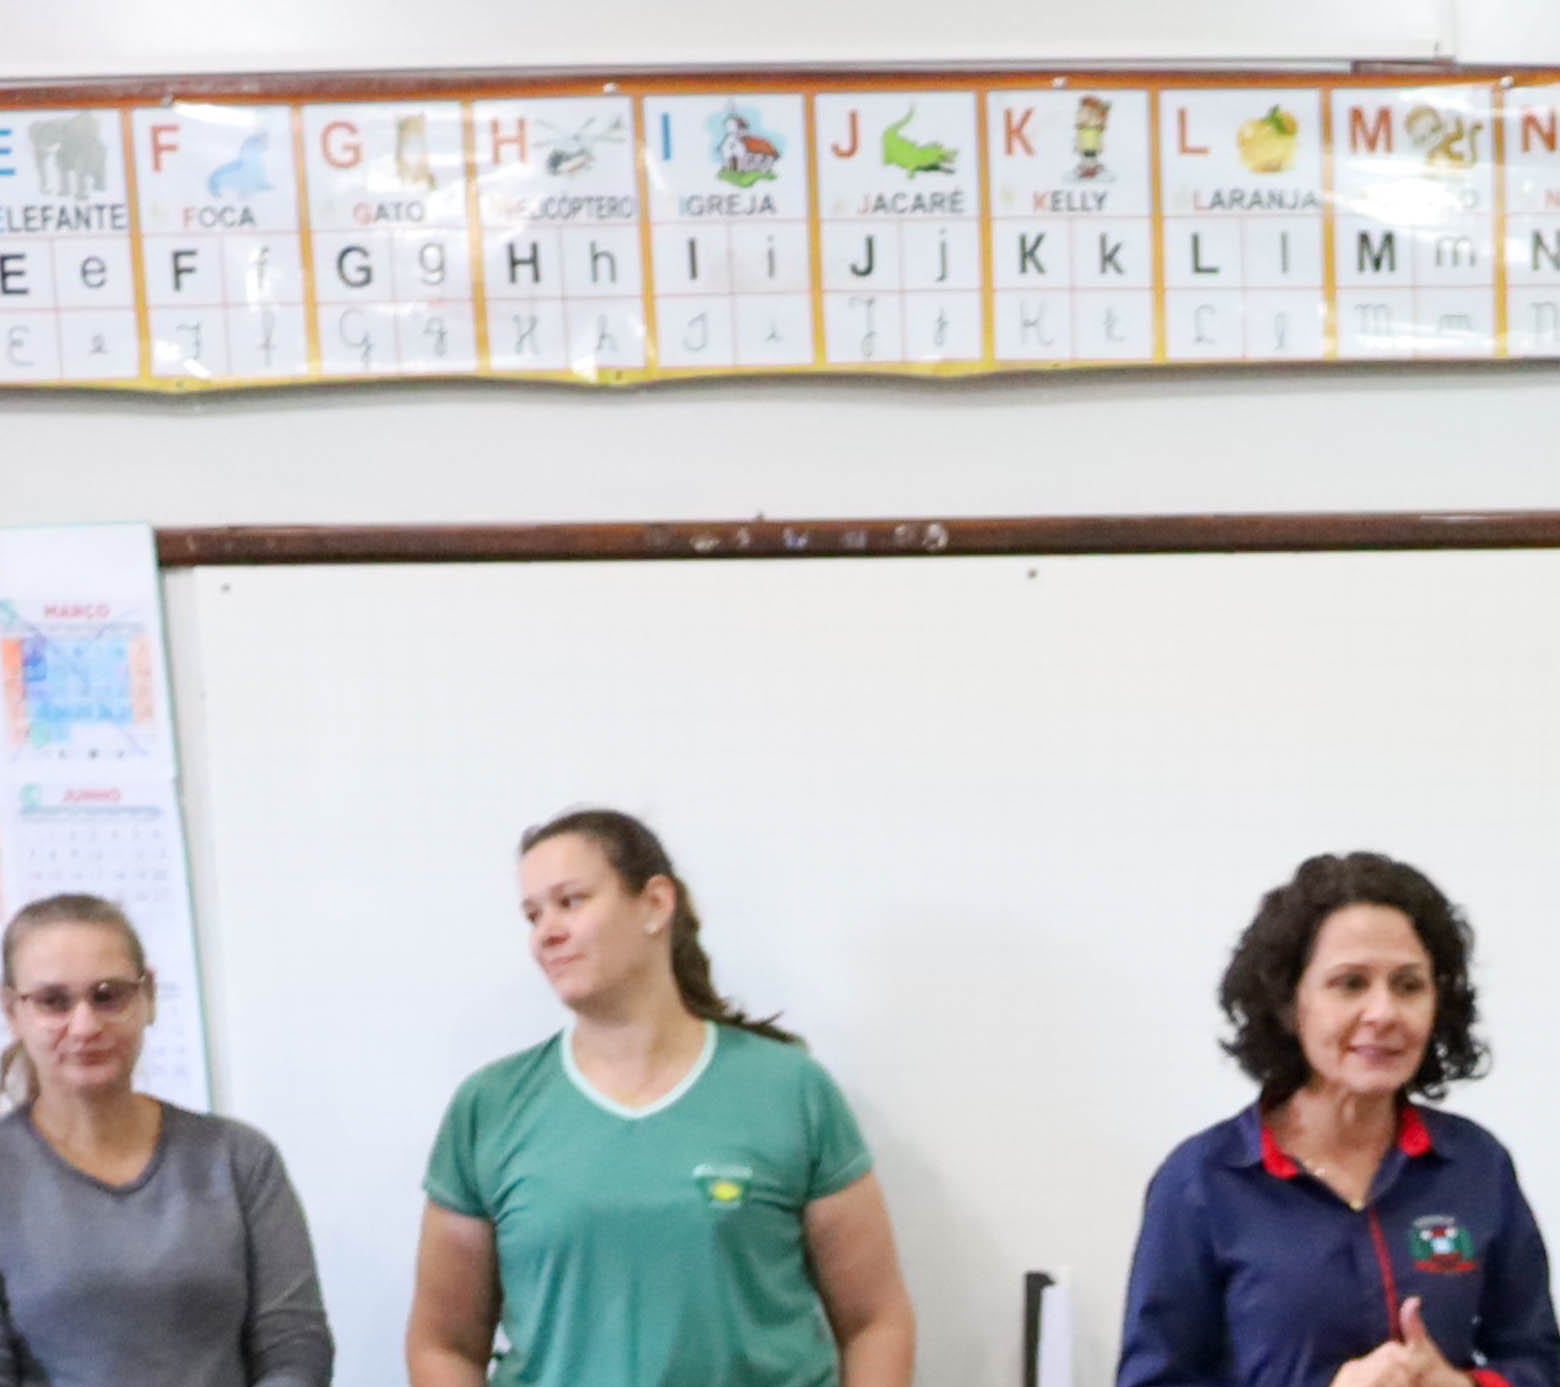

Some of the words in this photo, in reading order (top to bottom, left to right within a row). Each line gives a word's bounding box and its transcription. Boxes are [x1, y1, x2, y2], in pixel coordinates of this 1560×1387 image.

[151, 126, 180, 172] F
[321, 121, 363, 170] G
[491, 118, 527, 165] H
[662, 114, 671, 160] I
[832, 110, 859, 157] J
[1004, 108, 1036, 155] K
[1179, 108, 1208, 154] L
[1349, 107, 1392, 152] M
[1521, 107, 1557, 152] N
[182, 207, 256, 230] FOCA
[354, 201, 424, 225] GATO
[678, 195, 776, 216] IGREJA
[859, 187, 963, 213] JACARÉ
[1033, 191, 1106, 212] KELLY
[1192, 188, 1321, 211] LARANJA
[173, 250, 197, 290] F
[337, 247, 372, 287] G
[419, 243, 445, 286] g
[509, 243, 540, 283] H
[591, 241, 616, 282] h
[688, 239, 699, 280] I
[851, 234, 874, 277] J
[936, 231, 948, 280] j
[1019, 234, 1045, 273] K
[1099, 234, 1122, 273] k
[1192, 233, 1219, 273] L
[1357, 232, 1396, 271] M
[0, 255, 27, 294] E
[81, 256, 106, 288] e
